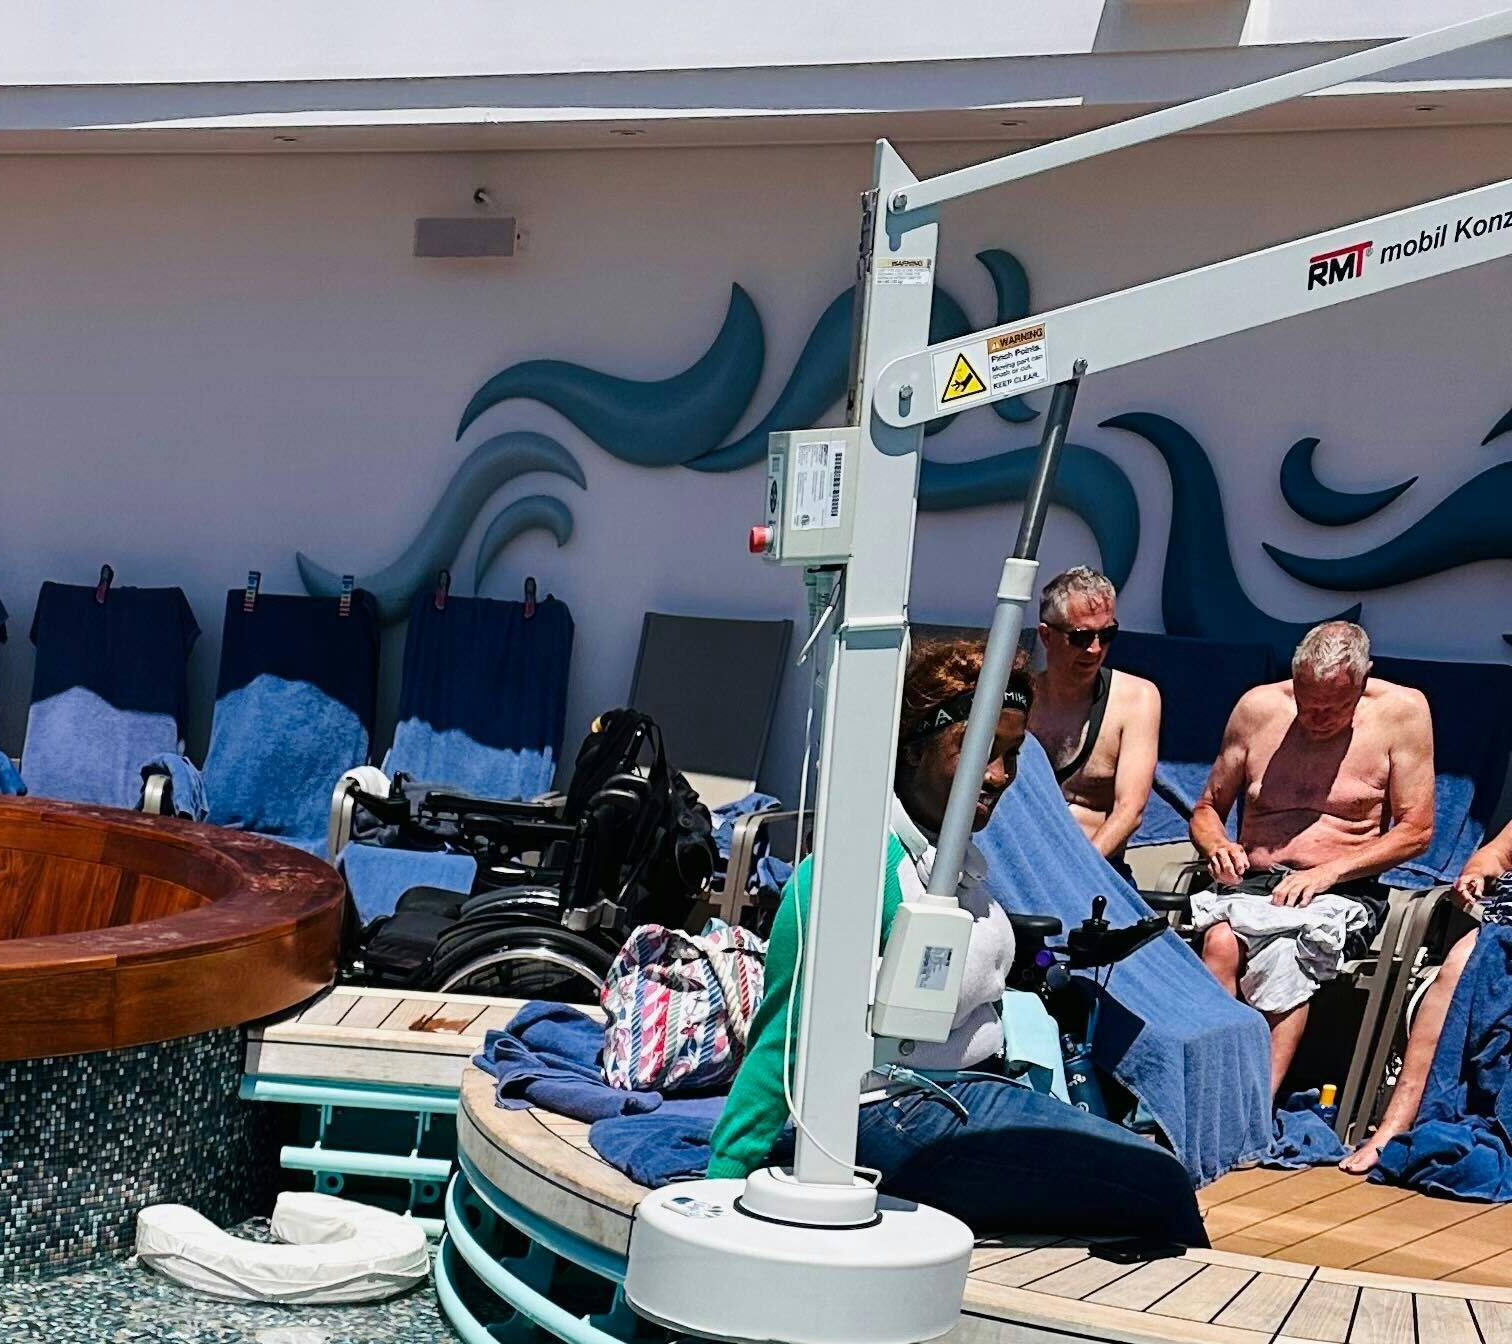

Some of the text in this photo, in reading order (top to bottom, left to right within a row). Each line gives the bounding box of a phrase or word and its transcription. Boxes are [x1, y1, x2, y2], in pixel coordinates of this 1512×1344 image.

[1307, 241, 1373, 291] RMT
[1380, 224, 1448, 264] mobil
[999, 328, 1043, 347] WARNING
[993, 379, 1012, 390] KEEP
